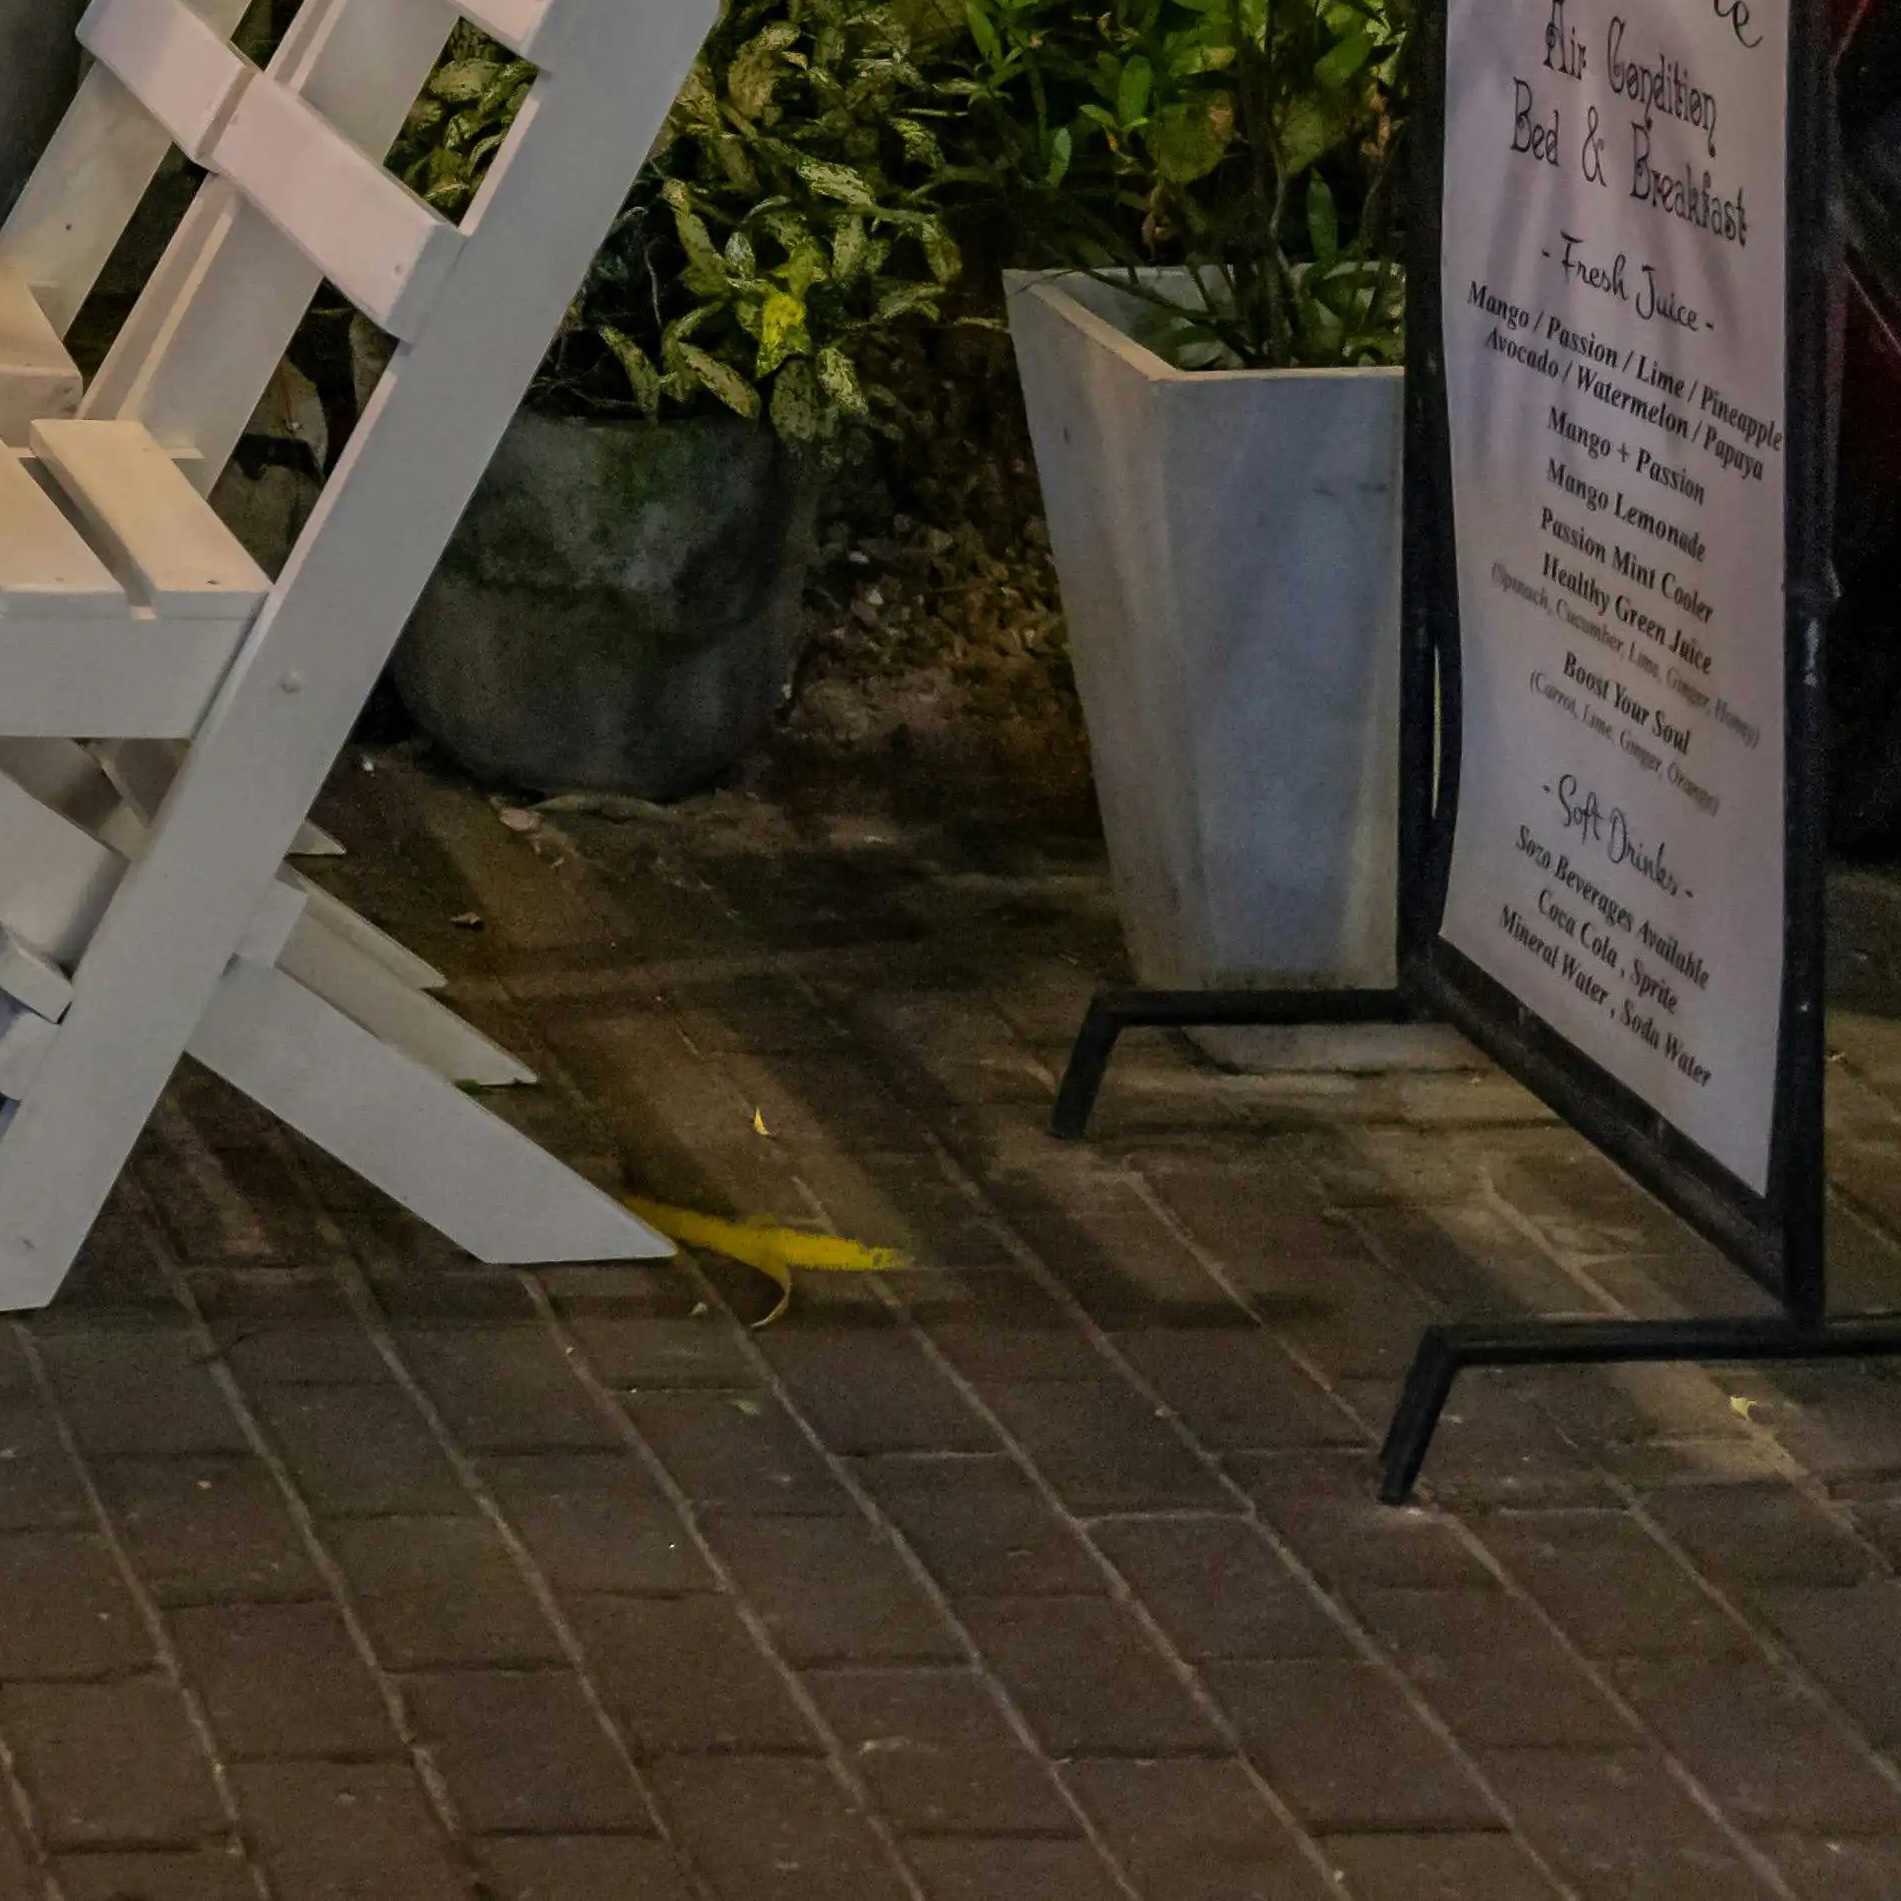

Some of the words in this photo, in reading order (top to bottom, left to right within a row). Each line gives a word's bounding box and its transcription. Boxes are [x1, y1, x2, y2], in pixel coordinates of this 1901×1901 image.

[1606, 15, 1717, 159] Condition
[1509, 77, 1561, 168] Bed
[1581, 106, 1607, 190] &
[1630, 119, 1747, 248] Breakfast
[1559, 227, 1629, 302] Fresh
[1634, 263, 1700, 333] Juice
[1466, 280, 1530, 331] Mango
[1546, 314, 1619, 370] Passion
[1635, 353, 1686, 400] Lime
[1699, 383, 1783, 453] Pineapple
[1484, 326, 1559, 380] Avocado
[1575, 363, 1688, 442] Watermelon
[1702, 425, 1764, 481] Papaya
[1546, 405, 1611, 461] Mango
[1634, 446, 1706, 506] Passion
[1546, 457, 1609, 511] Mango
[1613, 491, 1707, 563] Lemonade
[1540, 506, 1607, 564] Passion
[1611, 544, 1657, 590] Mint
[1660, 571, 1715, 625] Cooler
[1541, 551, 1611, 616] Healthy
[1614, 592, 1667, 647] Green
[1667, 628, 1713, 677] Juice
[1562, 649, 1610, 697] Boost
[1612, 679, 1651, 727] Your
[1651, 708, 1694, 755] Soul
[1557, 773, 1604, 844] Soft
[1607, 806, 1680, 897] Drinks
[1514, 824, 1551, 870] Sozo
[1554, 853, 1634, 935] Beverages
[1635, 910, 1711, 991] Available
[1537, 888, 1577, 939] Coca
[1628, 961, 1679, 1015] Sprite
[1499, 903, 1559, 969] Mineral
[1560, 948, 1610, 1007] Water
[1618, 999, 1660, 1052] Soda
[1662, 1031, 1714, 1088] Water
